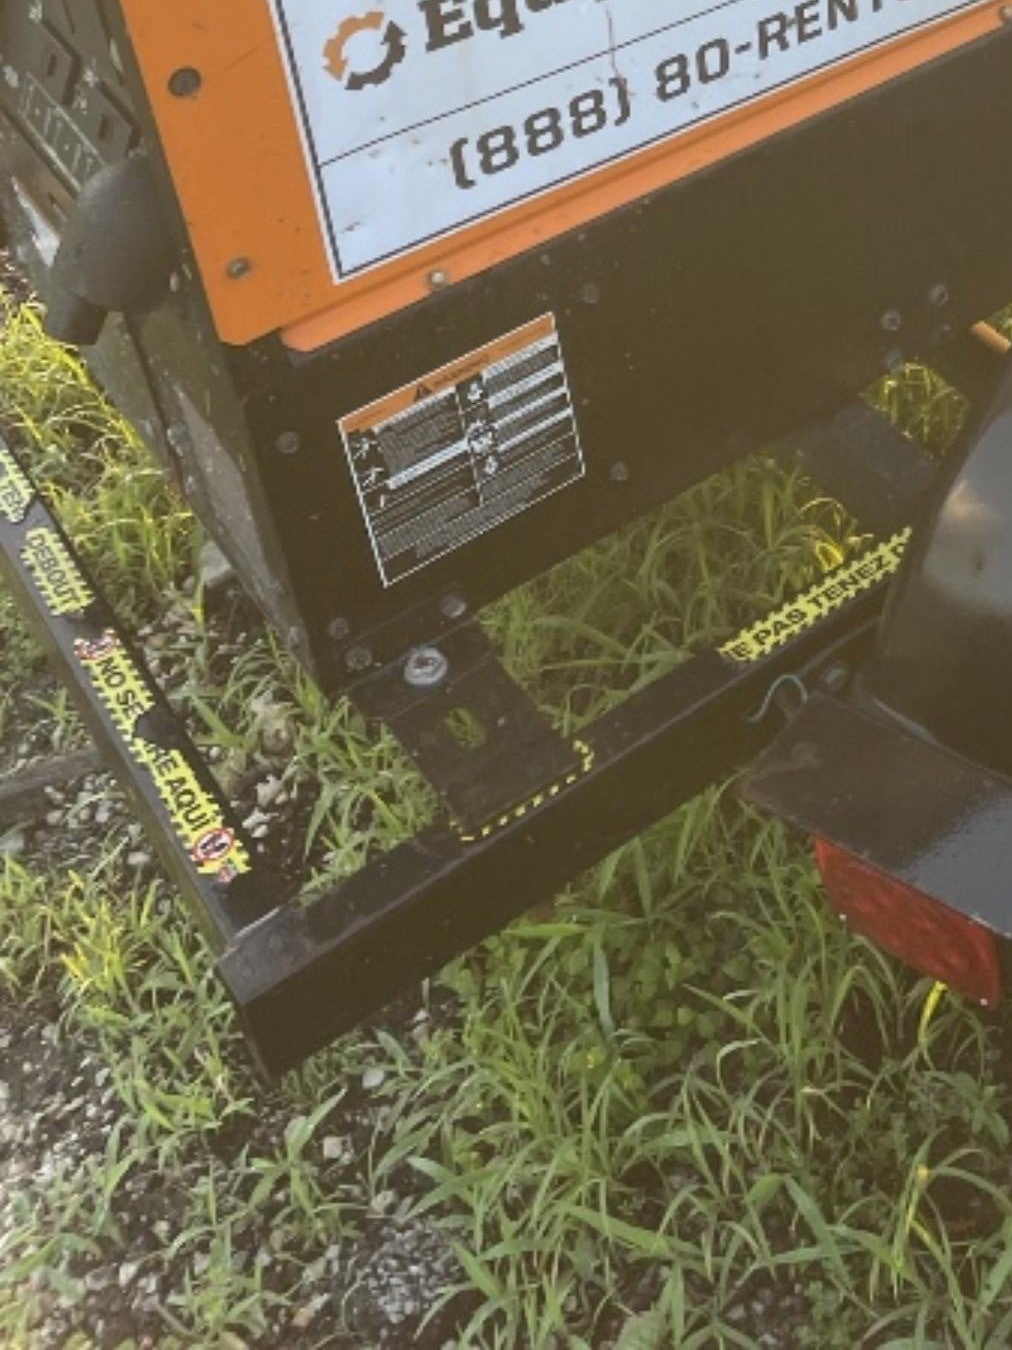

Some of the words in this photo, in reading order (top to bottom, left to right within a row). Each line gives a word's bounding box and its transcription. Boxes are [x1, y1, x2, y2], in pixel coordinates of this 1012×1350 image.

[448, 77, 632, 190] (888)
[31, 533, 78, 606] DEBOUT
[95, 656, 127, 689] NO
[115, 690, 145, 718] SE
